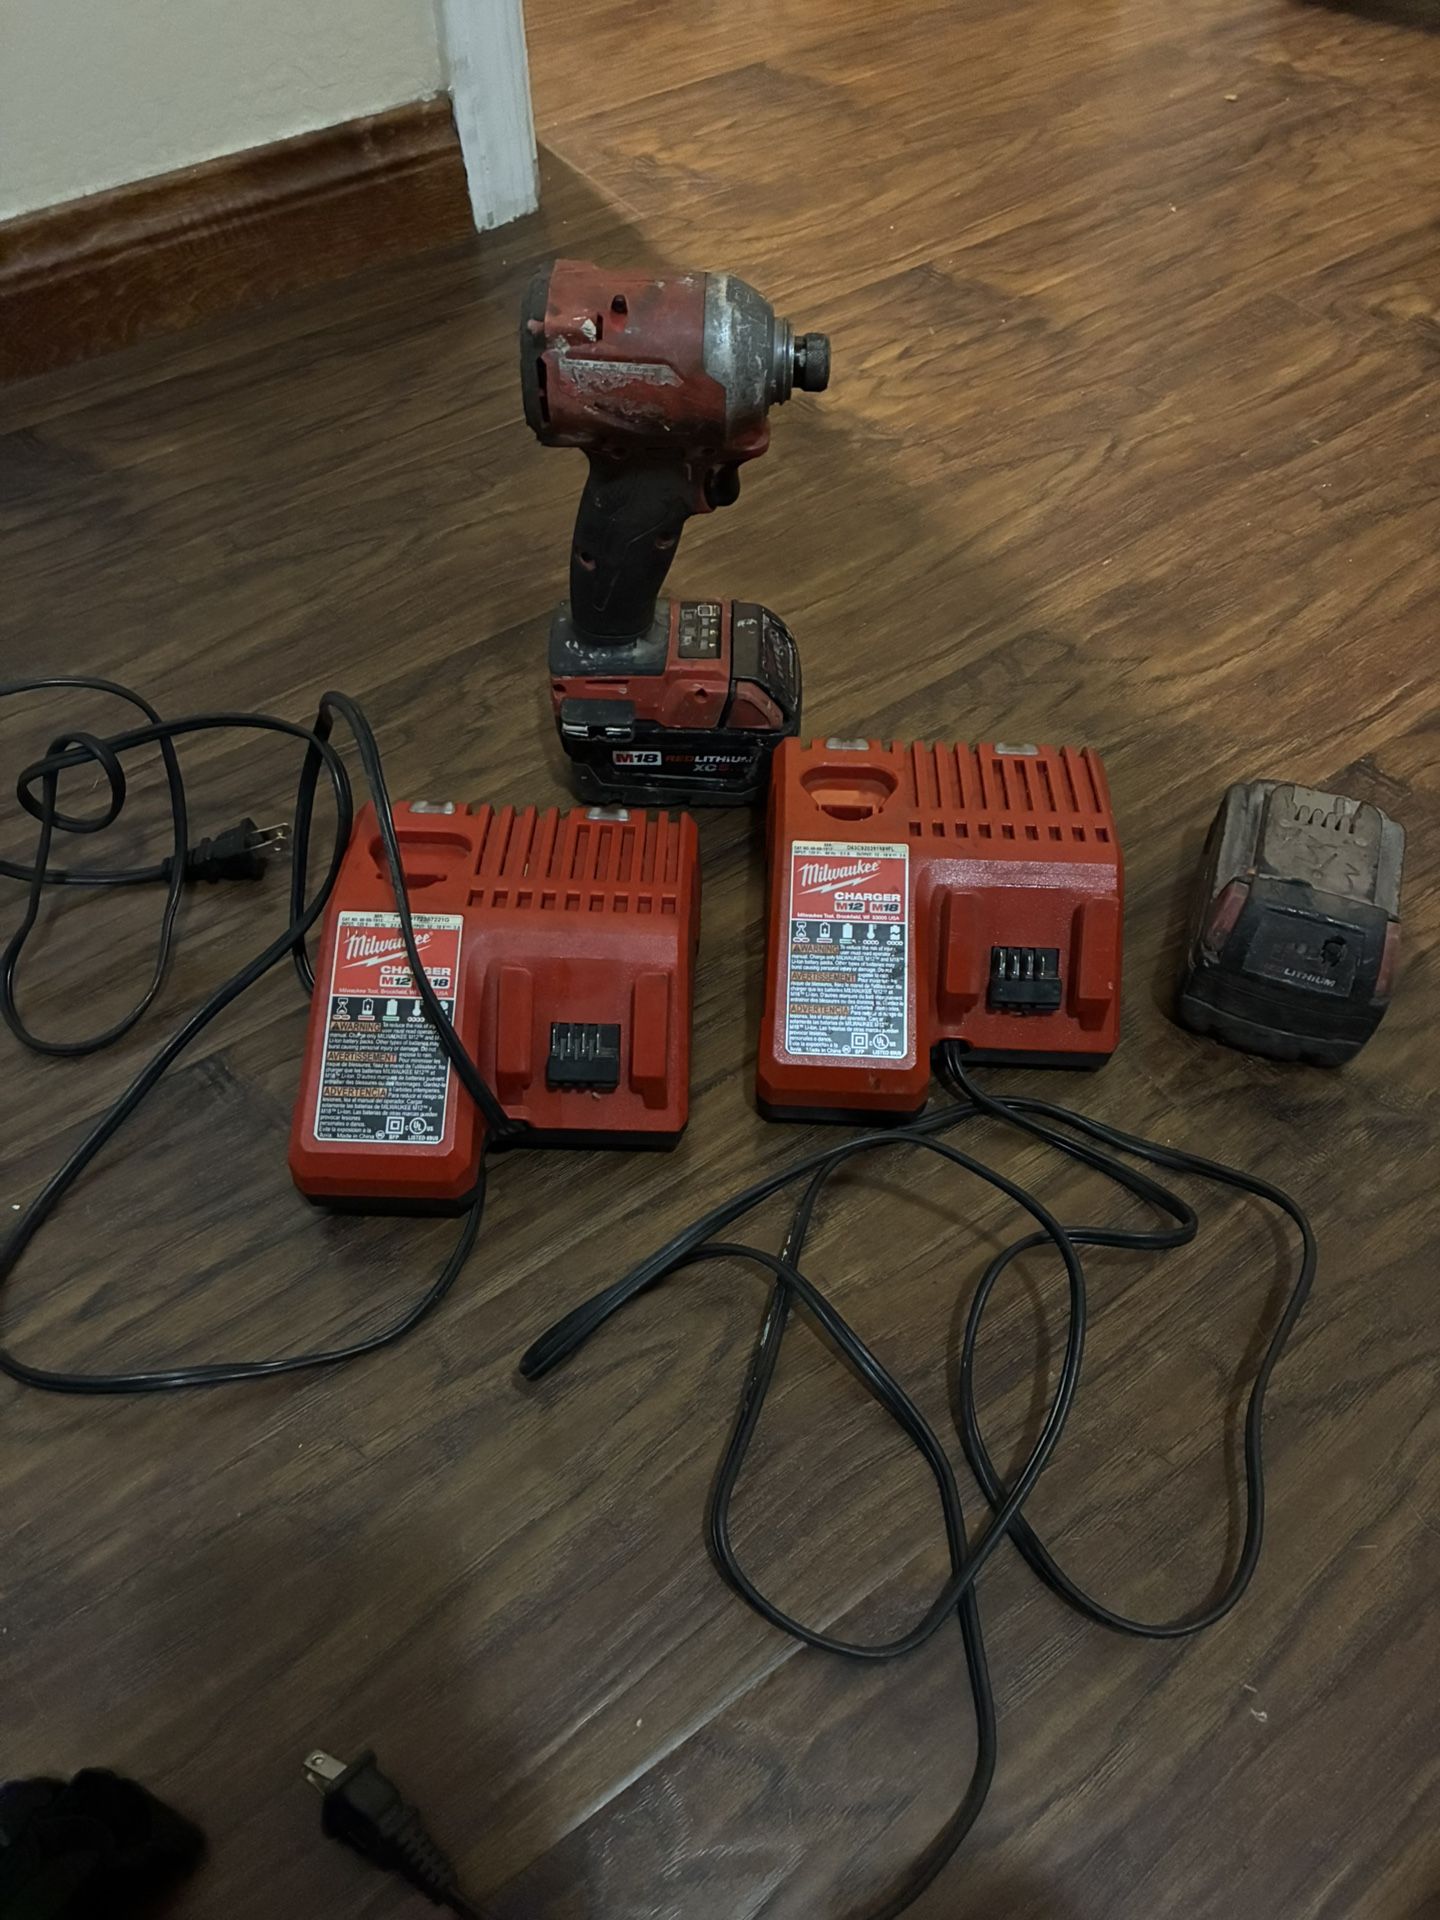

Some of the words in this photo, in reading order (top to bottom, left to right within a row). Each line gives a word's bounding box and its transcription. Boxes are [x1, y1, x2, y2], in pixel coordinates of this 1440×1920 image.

[614, 753, 659, 764] M18
[797, 860, 881, 886] Milwaukee
[834, 892, 901, 902] CHARGER
[835, 902, 865, 911] M12
[871, 902, 900, 913] M18
[343, 933, 432, 960] Milwauee
[801, 945, 839, 955] WARNING
[380, 965, 452, 976] CHAGER
[381, 975, 411, 986] M12
[792, 972, 856, 983] AVERTISSEMENT
[791, 1005, 848, 1015] ADVERTENCIA
[341, 1022, 380, 1032] WARNING
[328, 1052, 396, 1062] AVERTISSEMENT
[324, 1086, 387, 1097] ADVERTENCIA
